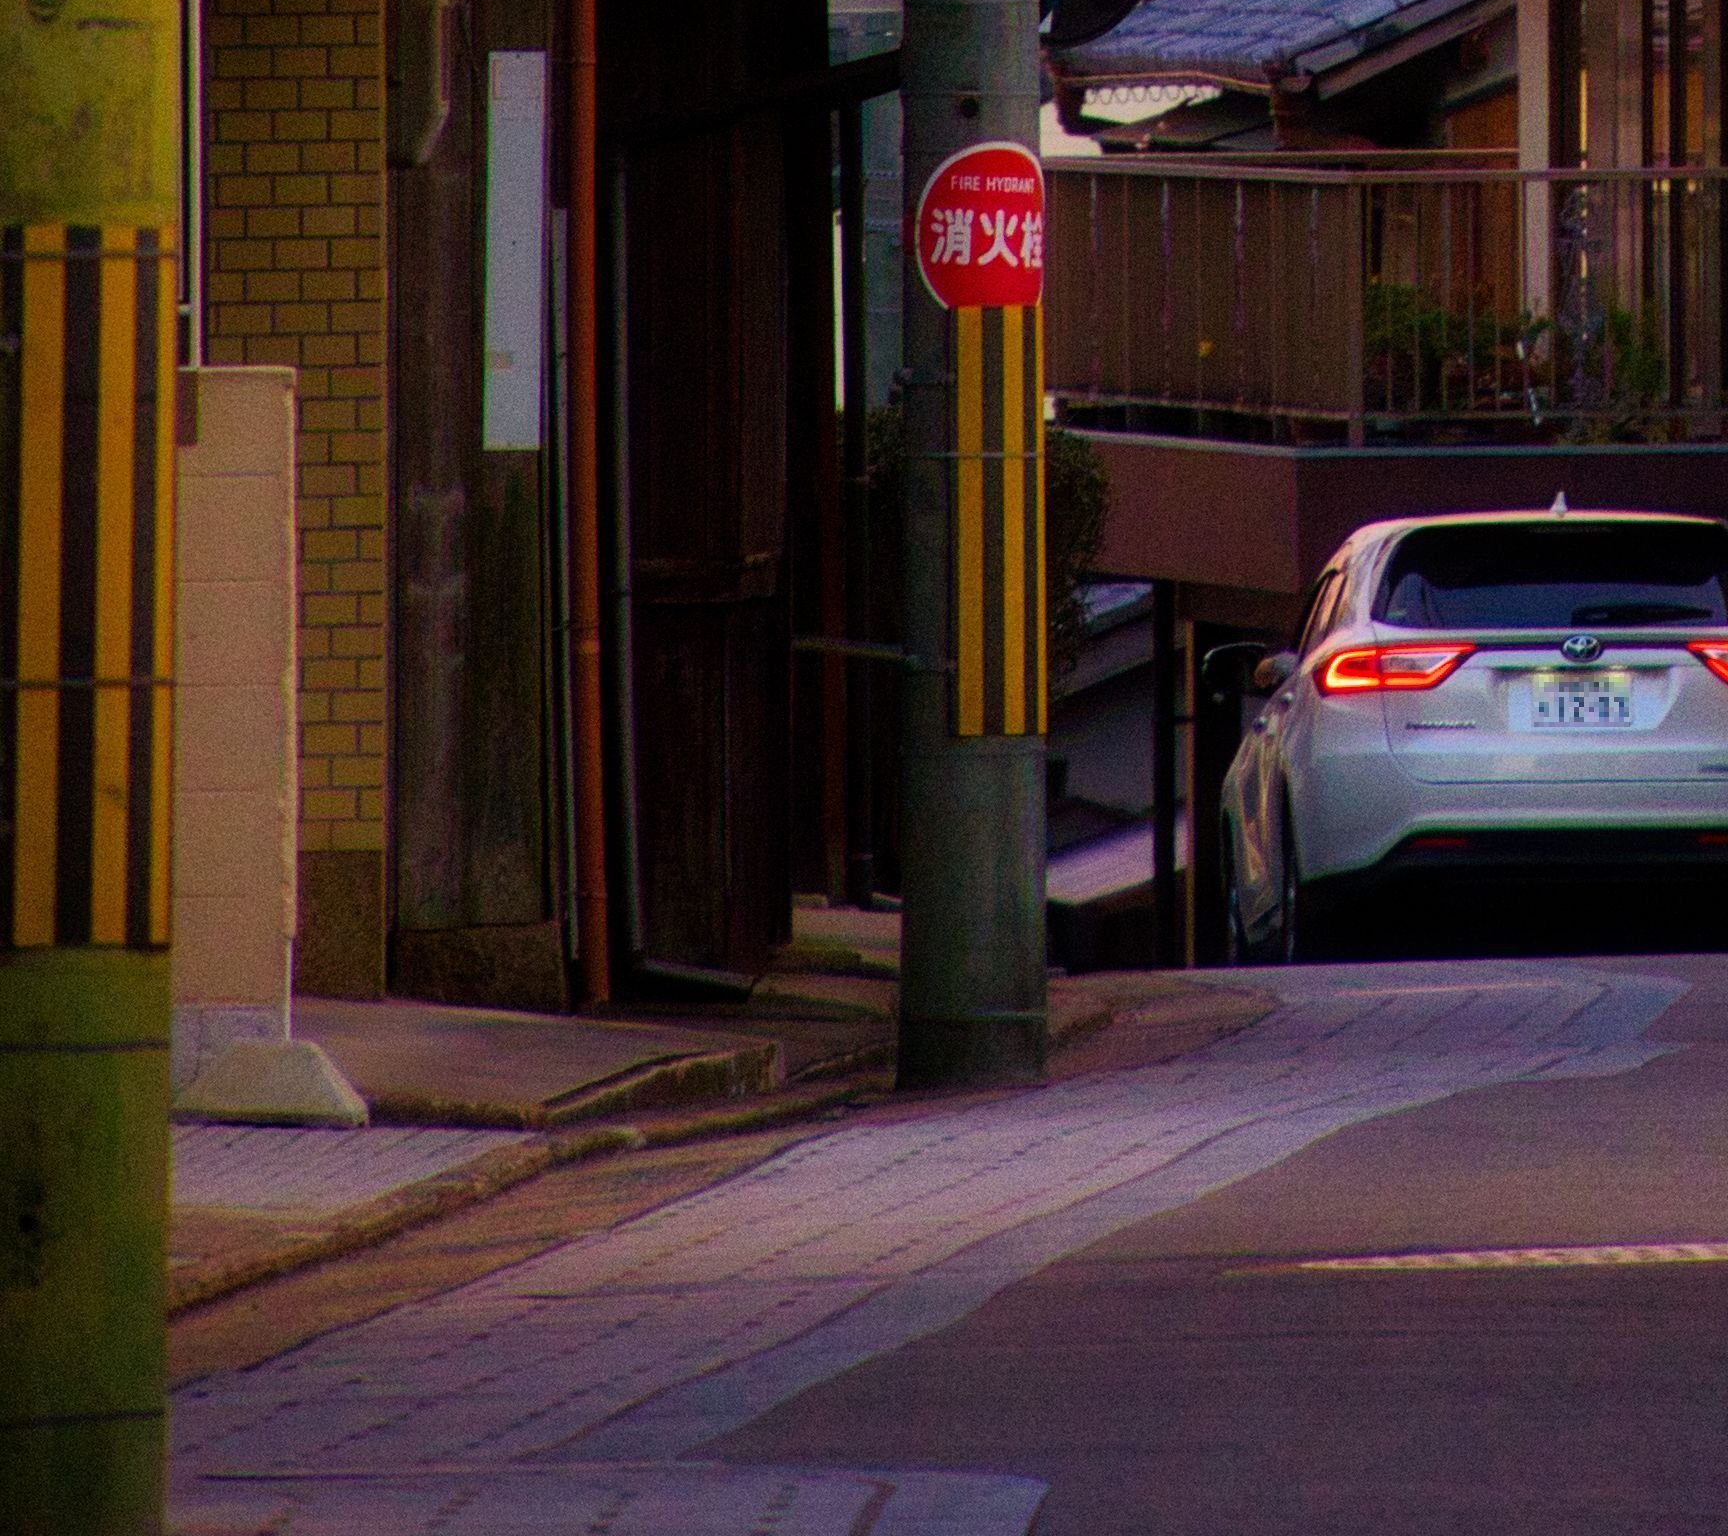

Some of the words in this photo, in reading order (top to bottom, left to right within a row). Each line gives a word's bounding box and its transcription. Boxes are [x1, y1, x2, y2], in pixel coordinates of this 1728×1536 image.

[950, 175, 981, 192] FIRE
[986, 176, 1035, 193] HYDRANT
[929, 207, 1043, 269] 消火栓
